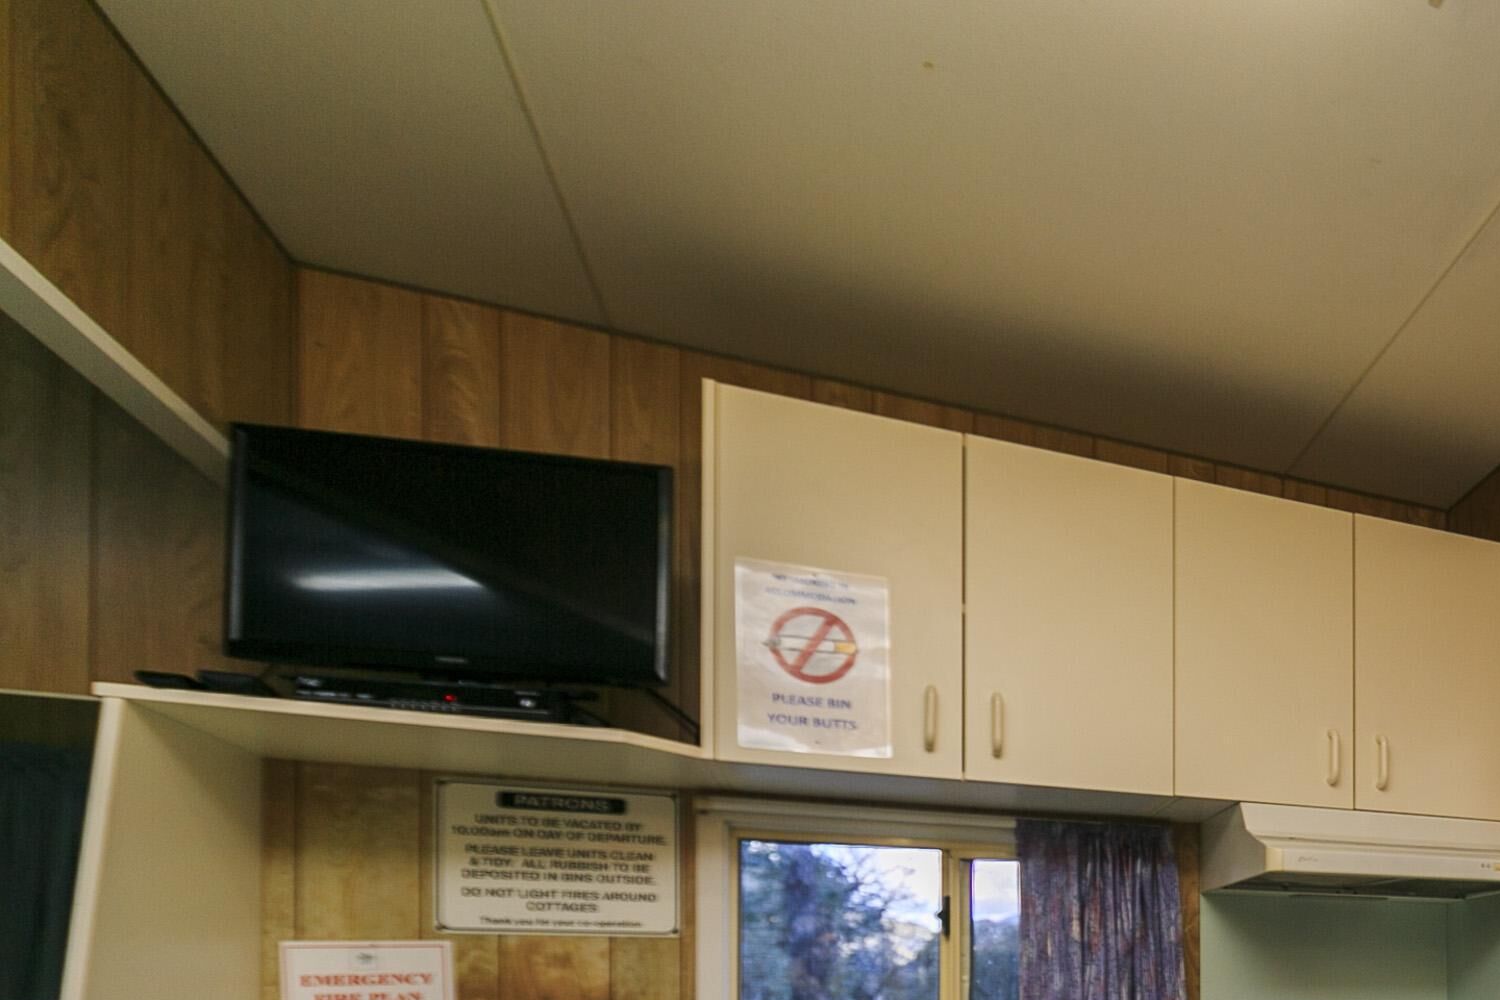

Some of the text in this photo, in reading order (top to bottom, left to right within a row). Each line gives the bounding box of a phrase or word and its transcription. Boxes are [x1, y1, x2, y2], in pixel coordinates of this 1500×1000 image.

[771, 692, 852, 709] PLEASE BIN
[768, 712, 857, 730] YOUR BUTTS
[513, 794, 609, 811] PATRONS
[473, 814, 518, 826] UNITS
[520, 816, 539, 827] TO
[542, 817, 561, 828] BE
[565, 819, 622, 831] VACATED
[513, 828, 534, 839] ON
[537, 830, 562, 840] DAY
[566, 831, 584, 841] OF
[464, 844, 654, 862] PLEASE LEAVE UNITS CLEAN
[522, 859, 545, 870] ALL
[550, 860, 609, 872] RUBBISH
[613, 862, 628, 873] TO
[632, 864, 650, 874] BE
[461, 869, 540, 882] DEPOSITED
[543, 872, 557, 881] IN
[561, 872, 593, 883] BINS
[461, 886, 657, 903] DO NOT LIGHT FIRES AROUND
[299, 973, 433, 988] EMERGENCY
